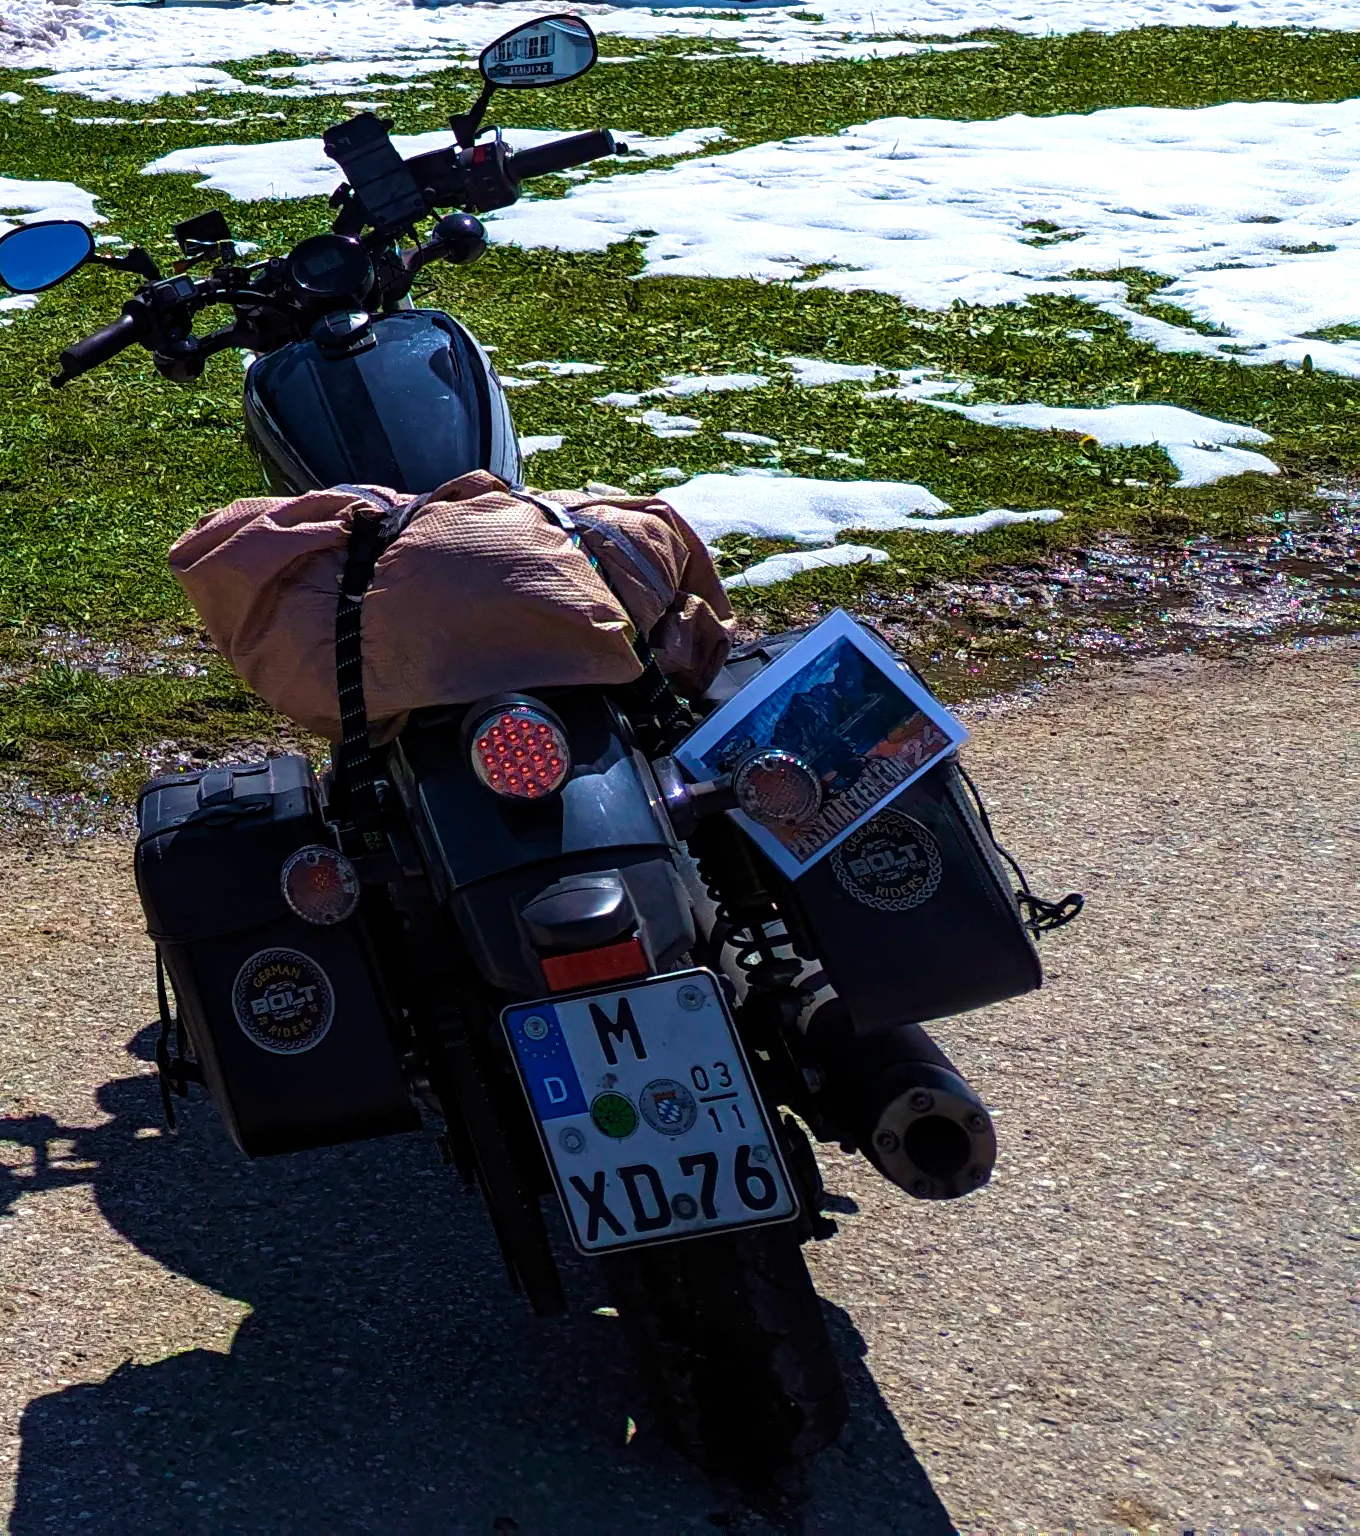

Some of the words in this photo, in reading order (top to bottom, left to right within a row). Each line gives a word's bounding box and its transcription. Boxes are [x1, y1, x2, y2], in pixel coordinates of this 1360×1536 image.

[846, 822, 904, 853] GERMAN
[847, 843, 918, 877] BOLT
[875, 874, 924, 898] RIDERS
[253, 964, 301, 988] GERMAN
[250, 985, 316, 1015] BOLT
[268, 1017, 312, 1038] RIDERS
[588, 997, 648, 1065] M
[543, 1076, 568, 1104] D
[690, 1062, 733, 1092] 03
[708, 1104, 746, 1133] 11
